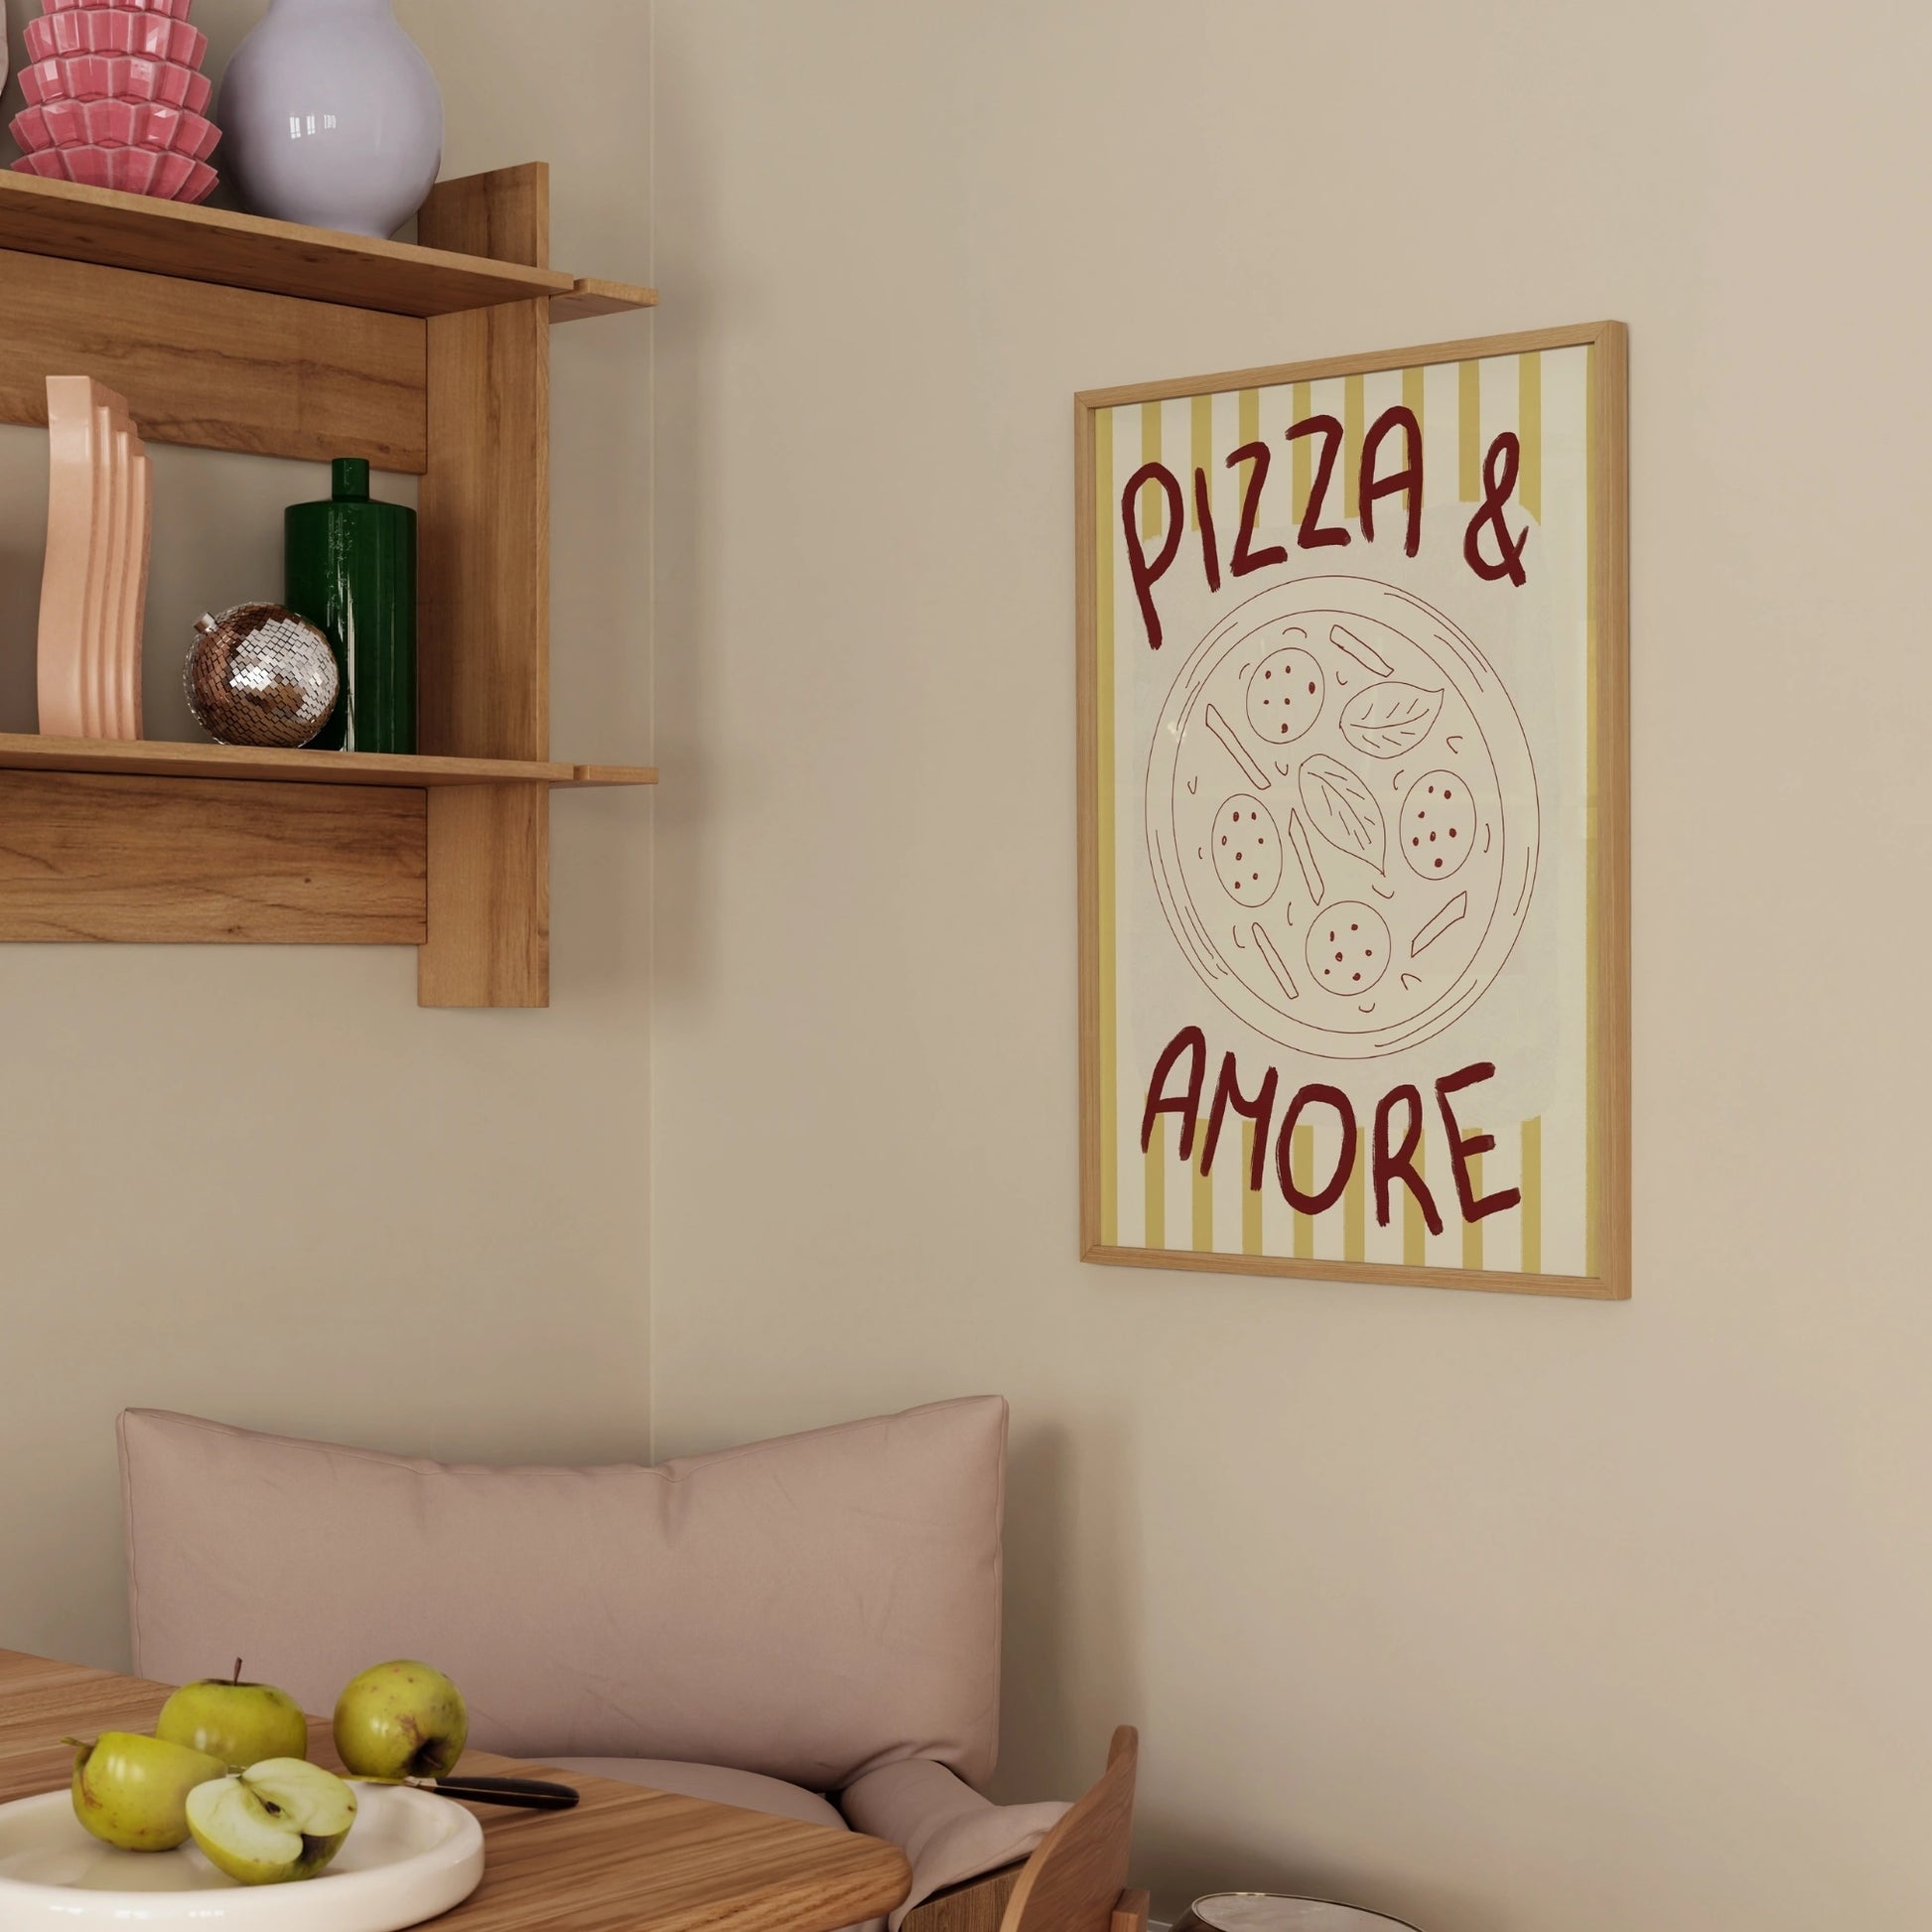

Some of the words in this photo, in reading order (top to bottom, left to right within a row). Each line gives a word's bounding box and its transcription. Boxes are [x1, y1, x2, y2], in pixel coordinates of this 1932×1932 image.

[1121, 405, 1424, 650] PIZZA
[1463, 431, 1530, 588] &
[1141, 1026, 1521, 1236] AMORE
